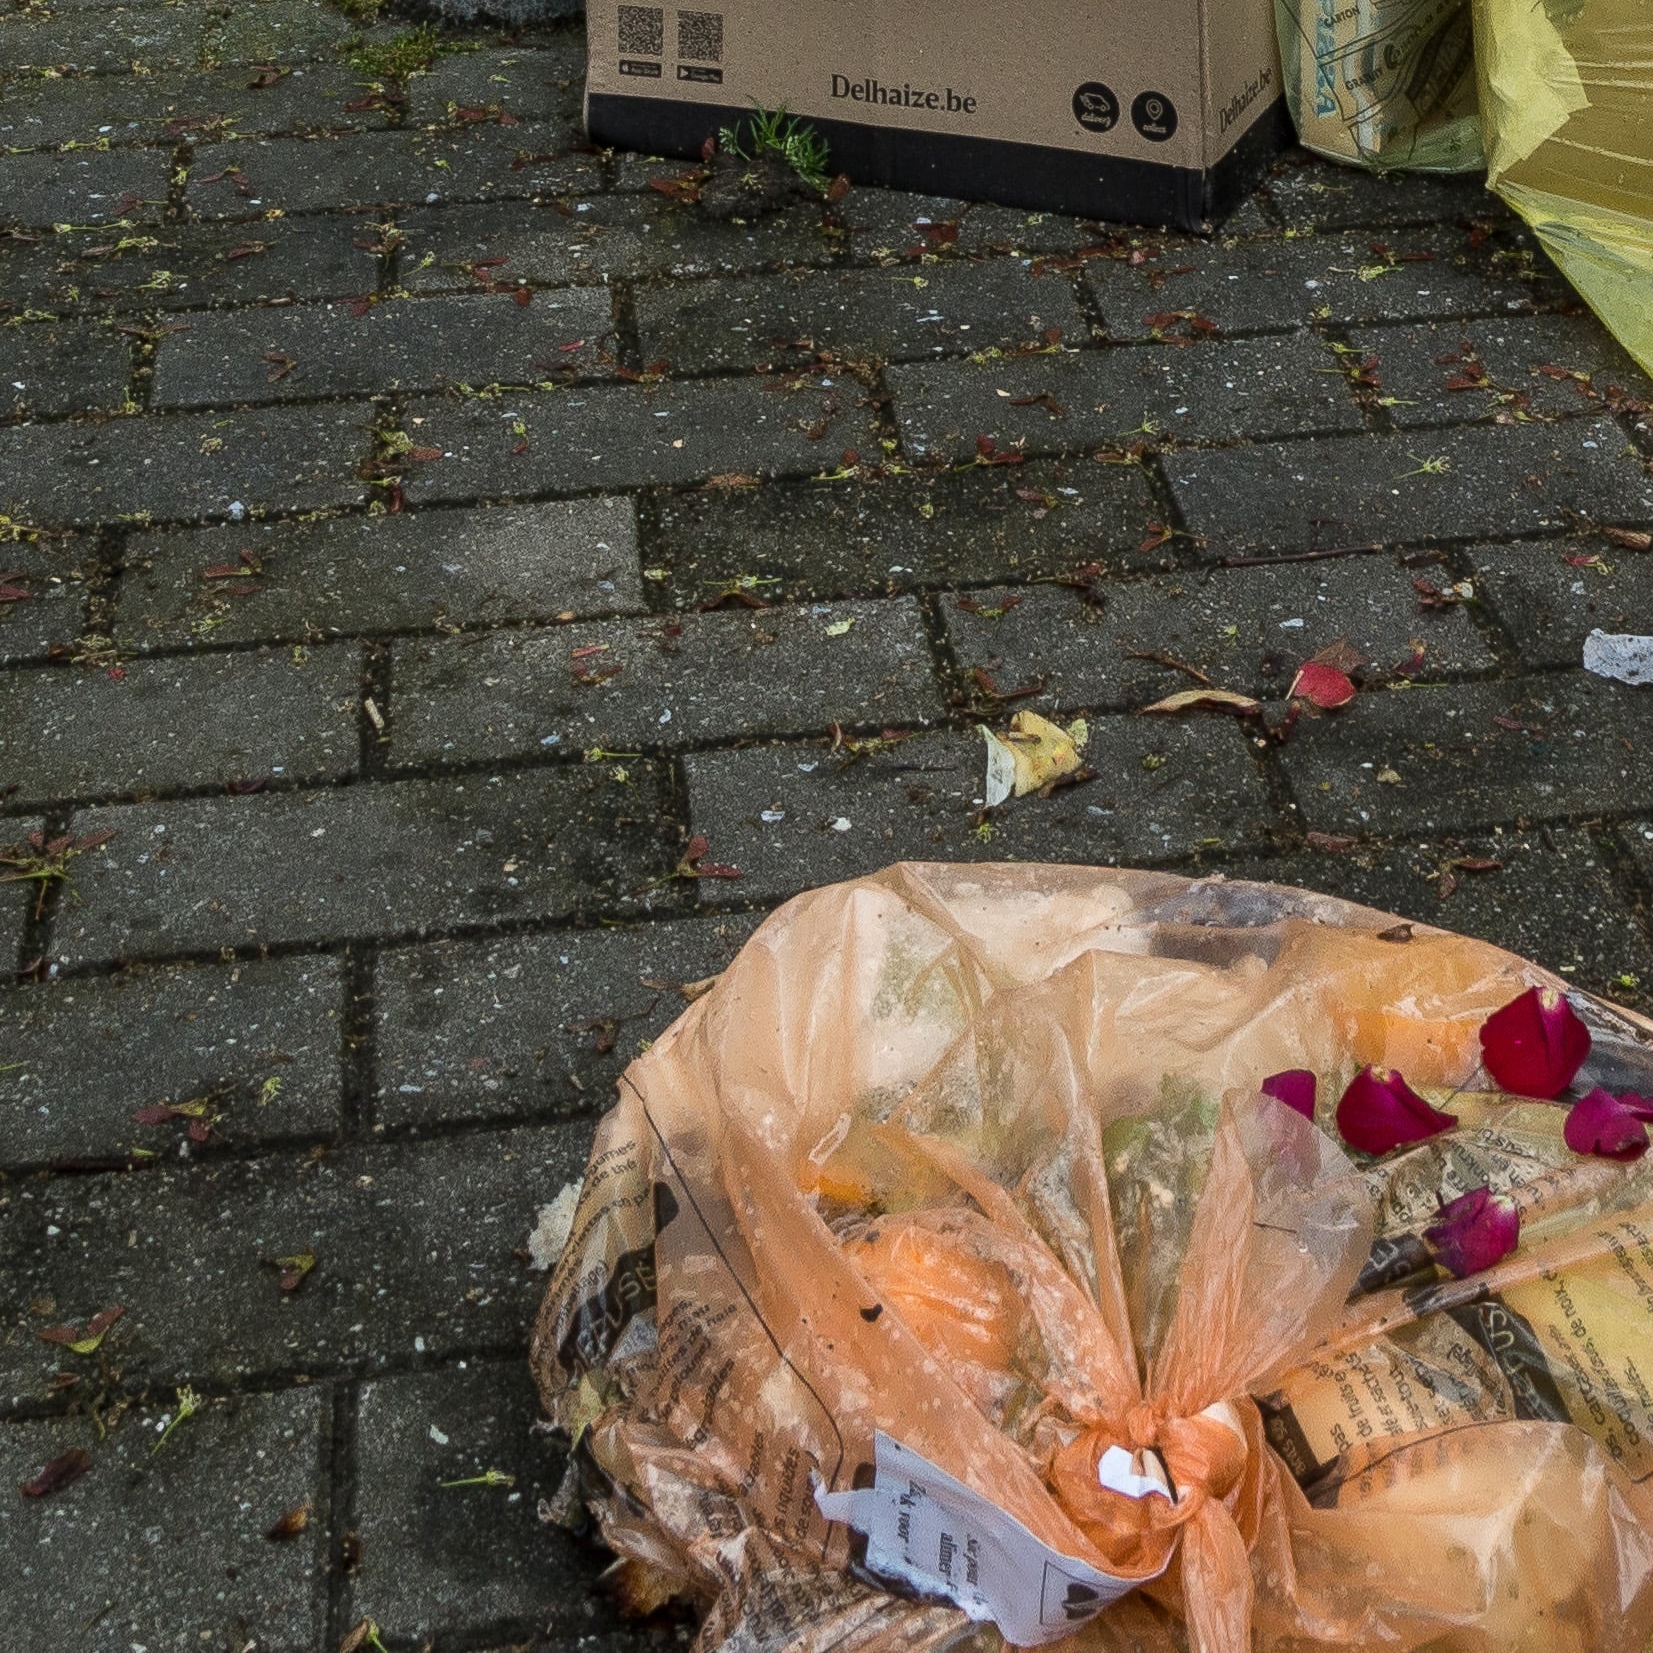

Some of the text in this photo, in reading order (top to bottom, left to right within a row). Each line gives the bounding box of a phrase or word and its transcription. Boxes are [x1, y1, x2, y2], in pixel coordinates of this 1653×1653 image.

[1323, 6, 1362, 29] CARTON
[829, 73, 979, 114] Delhaize.be
[1218, 66, 1273, 138] Delhaize.be
